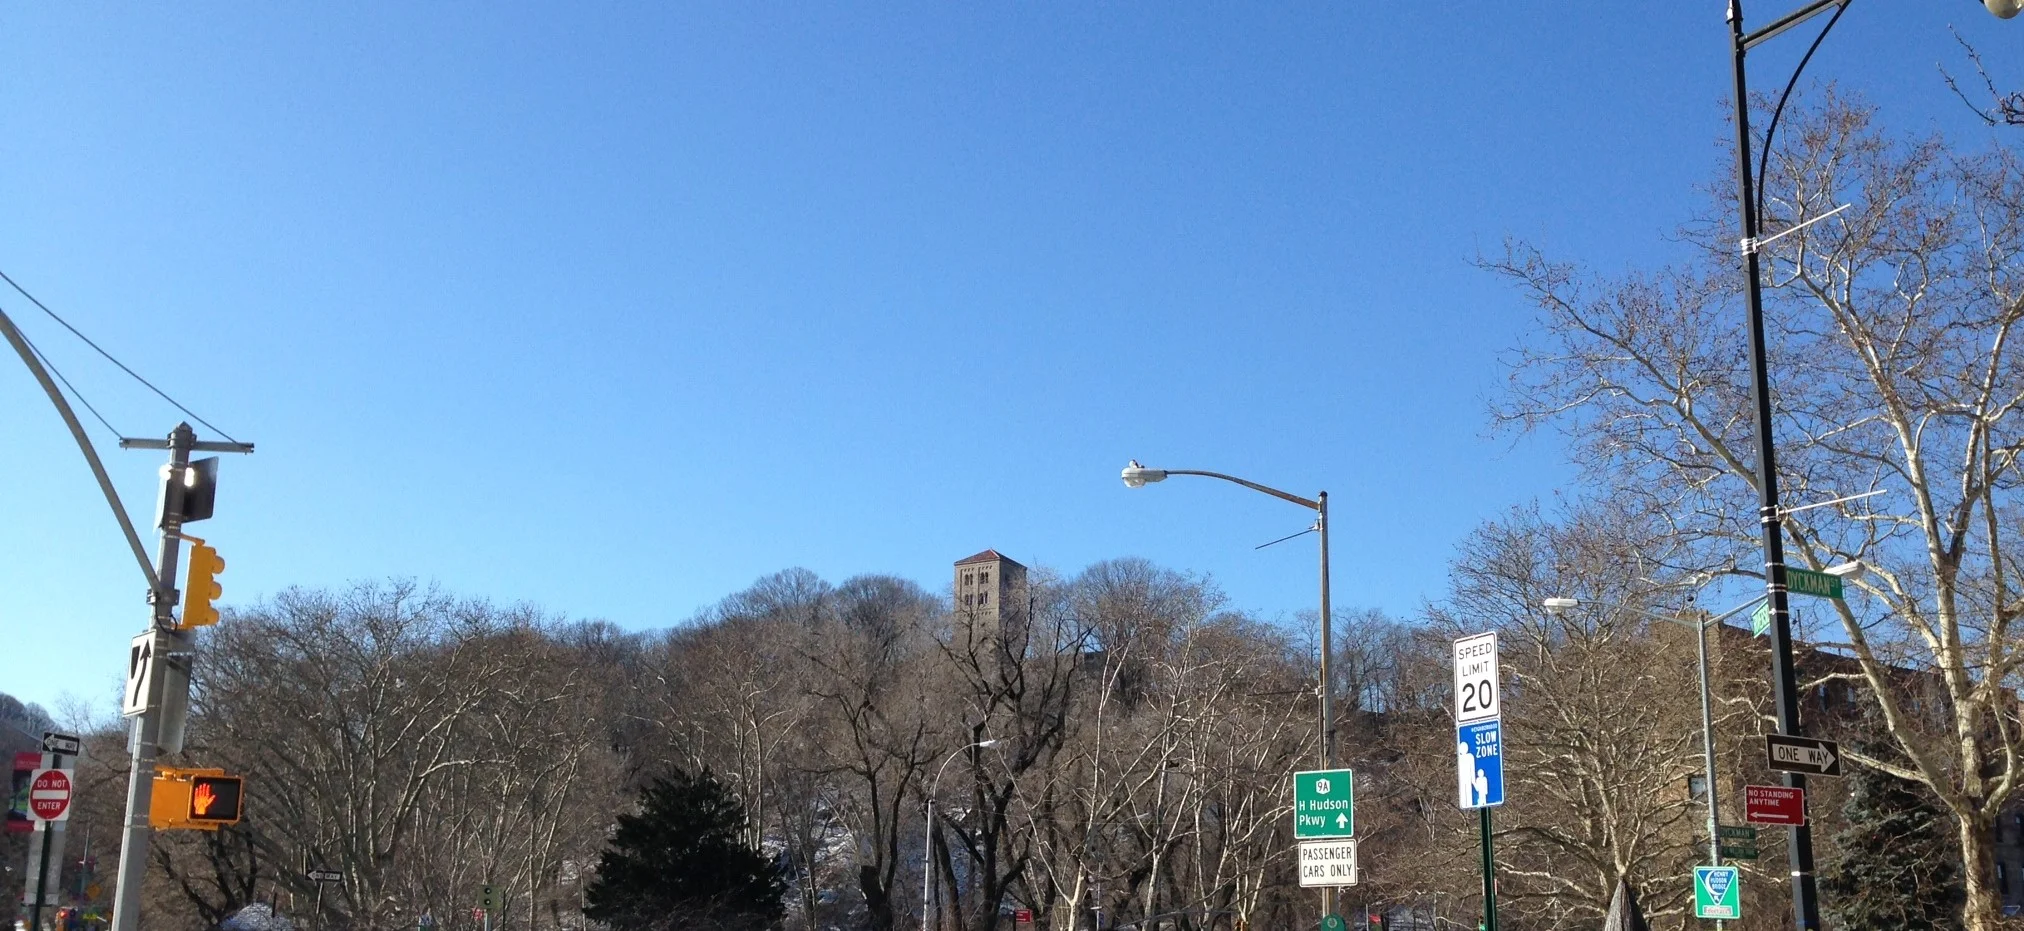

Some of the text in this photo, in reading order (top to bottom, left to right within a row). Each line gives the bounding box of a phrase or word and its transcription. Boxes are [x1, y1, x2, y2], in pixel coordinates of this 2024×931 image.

[1787, 570, 1839, 597] DYCKMAN ST
[1458, 642, 1492, 660] SPEED
[1462, 661, 1489, 677] LIMIT
[1462, 679, 1492, 713] 20
[1475, 730, 1497, 745] SLOW
[1476, 744, 1498, 758] ZONE
[1778, 746, 1829, 764] ONE WAY
[37, 780, 66, 788] DO NOT
[1317, 781, 1329, 791] 9A
[1760, 791, 1794, 799] STANDING
[38, 801, 61, 810] ENTER
[1299, 798, 1348, 811] H Hudson
[1749, 798, 1780, 806] ANYTIME
[1299, 814, 1326, 828] Pkwy
[1303, 847, 1352, 860] PASSENGER
[1303, 864, 1352, 877] CARS ONLY
